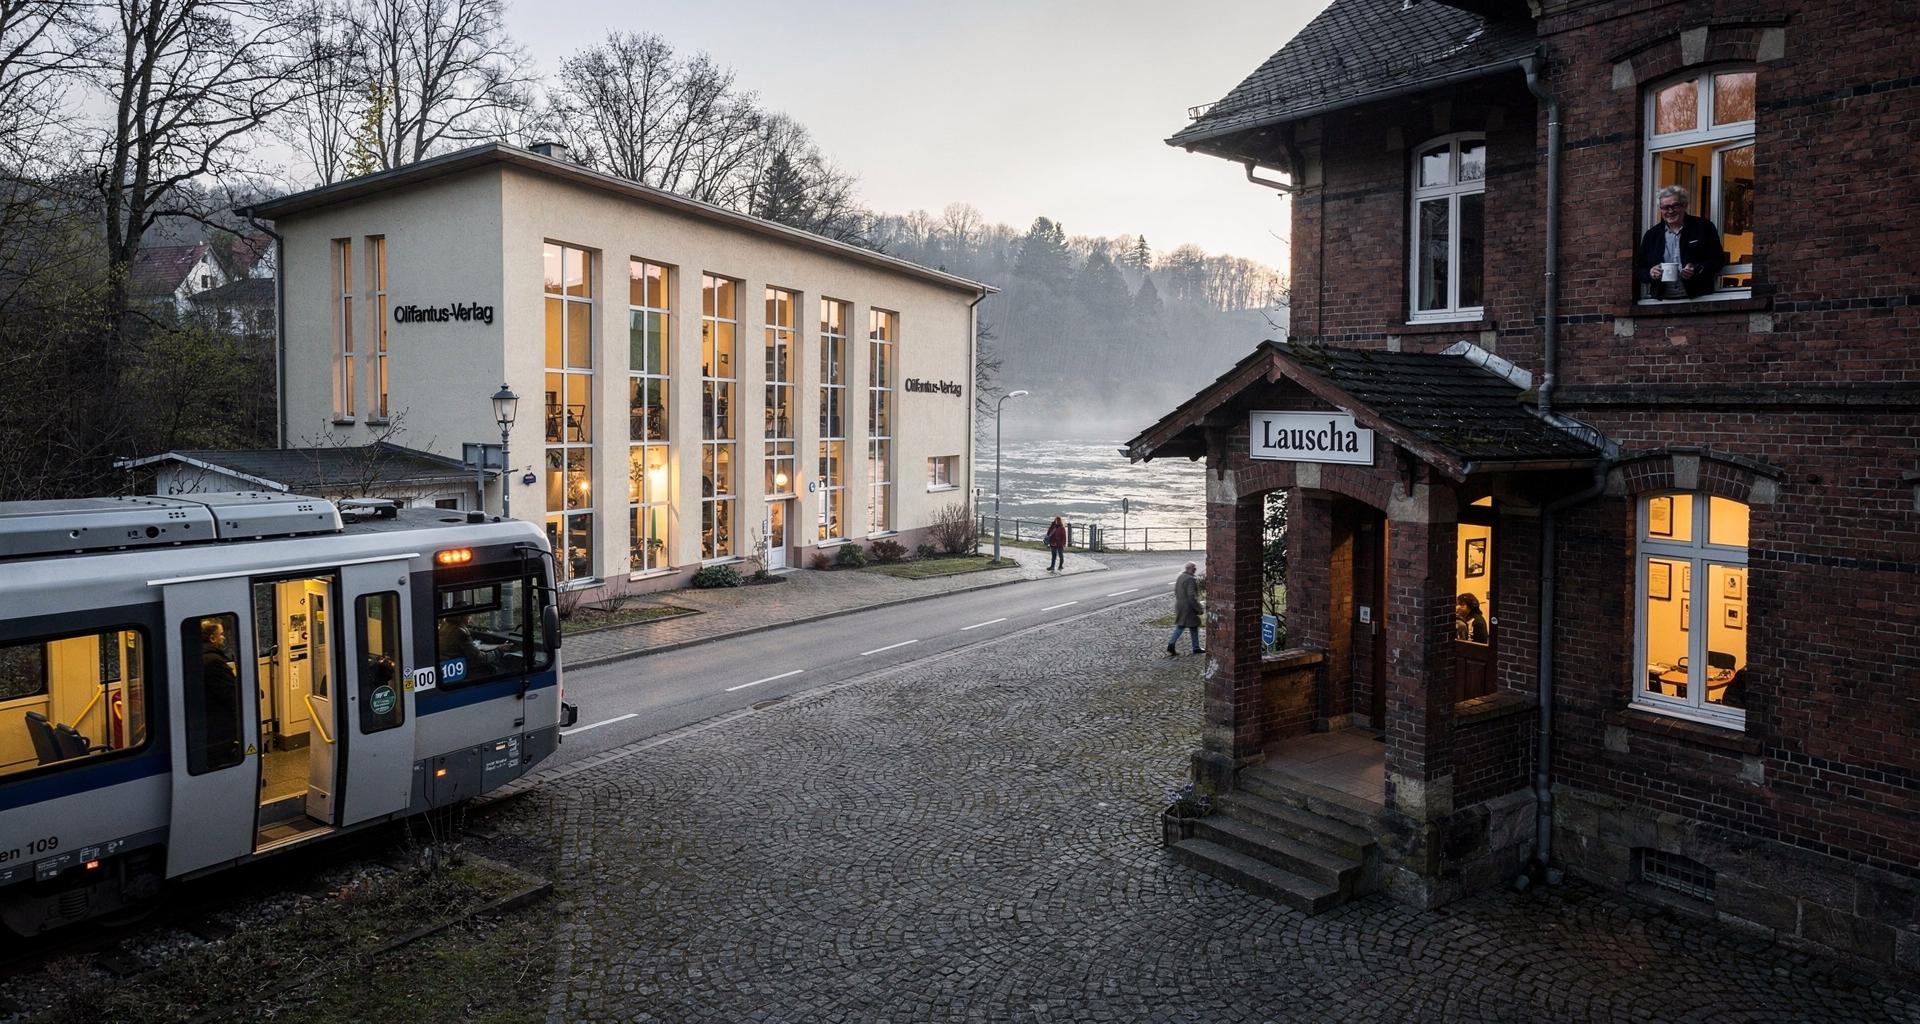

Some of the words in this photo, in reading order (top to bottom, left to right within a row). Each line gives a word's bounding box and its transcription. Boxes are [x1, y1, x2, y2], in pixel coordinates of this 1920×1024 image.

[394, 302, 494, 325] Olifantus-Verlag
[1262, 420, 1359, 453] Lauscha
[413, 670, 434, 688] 100
[442, 661, 464, 679] 109
[26, 836, 59, 855] 109
